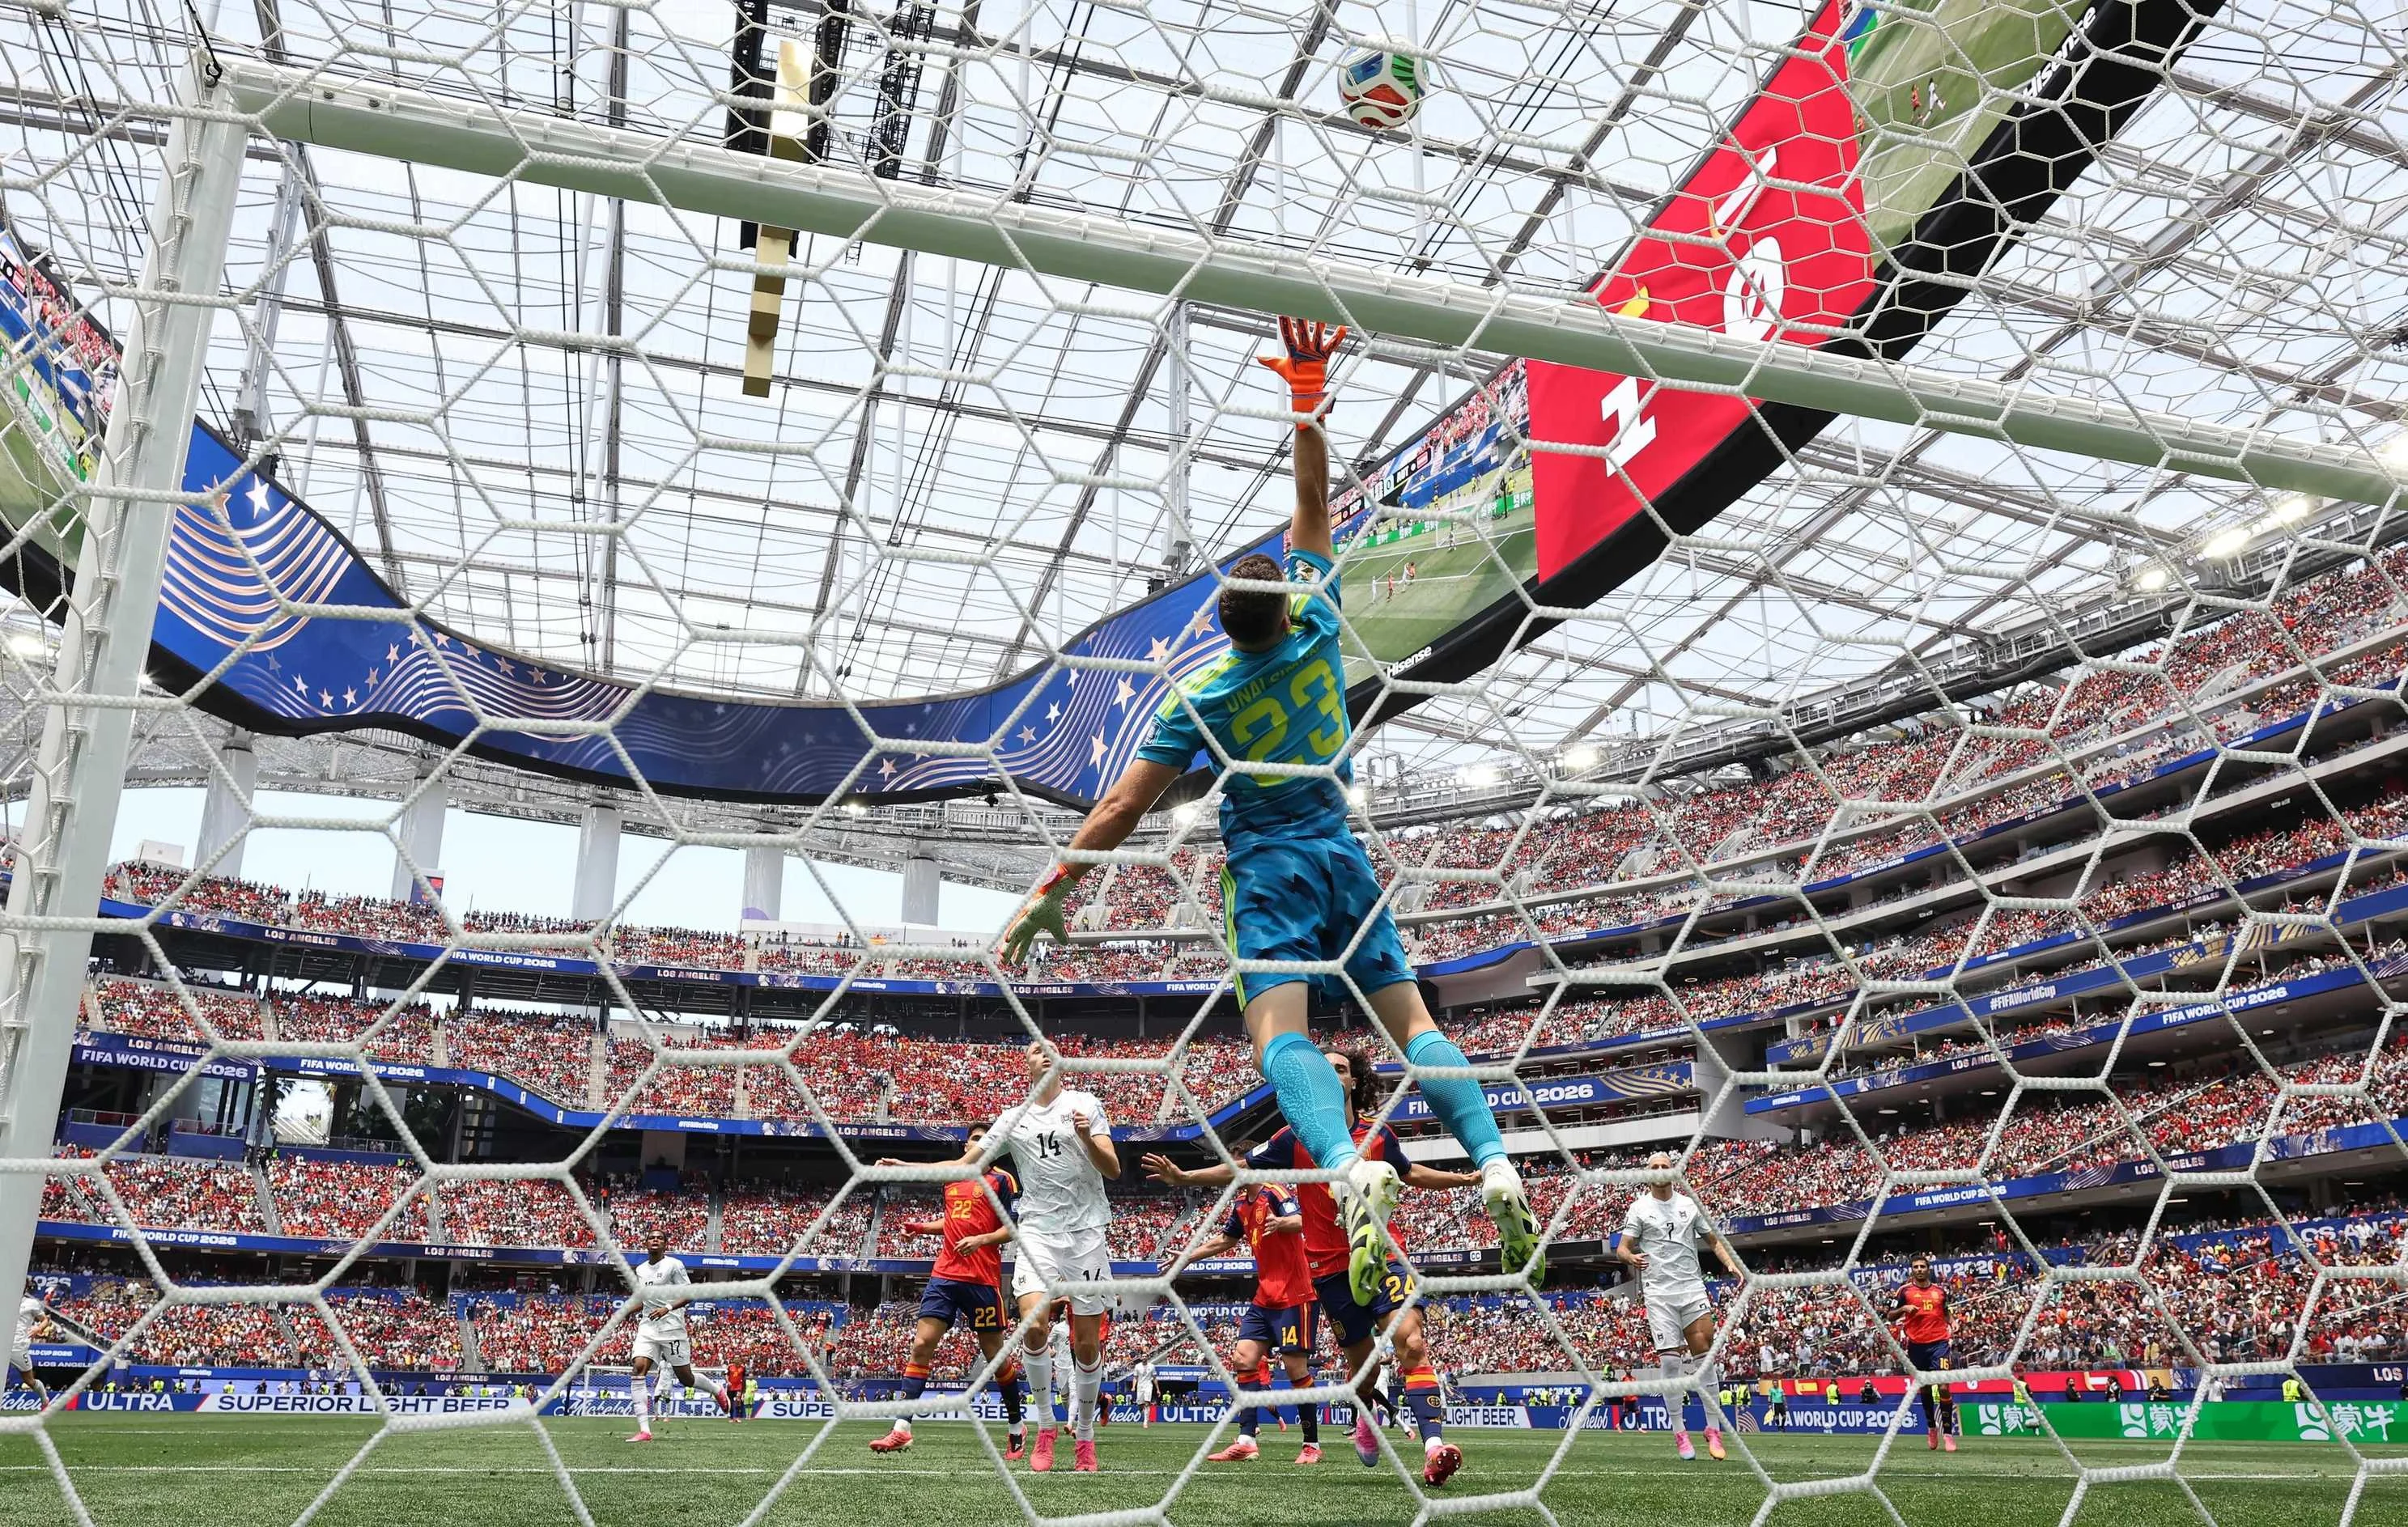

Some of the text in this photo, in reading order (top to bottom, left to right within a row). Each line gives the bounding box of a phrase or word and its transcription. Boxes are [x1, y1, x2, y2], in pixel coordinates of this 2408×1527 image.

[1387, 646, 1432, 677] Hisense
[1225, 677, 1268, 713] UNAI
[1231, 659, 1345, 788] 23
[2172, 893, 2219, 910] LOS ANGELES
[265, 930, 338, 945] LOS ANGELES
[469, 952, 503, 964] WORLD
[503, 955, 522, 965] CUP
[524, 958, 557, 968] 2026
[657, 969, 721, 981] LOS ANGELES
[1013, 986, 1074, 995] LOS ANGELES
[1166, 983, 1184, 991] FIFA
[1185, 982, 1216, 991] WORLD
[1990, 985, 2056, 1011] #FIFAWorldCup
[2163, 1009, 2185, 1024] FIFA
[2224, 997, 2247, 1011] CUP
[2248, 986, 2288, 1005] 2026
[129, 1039, 210, 1056] LOS ANGELES
[82, 1050, 113, 1063] FIFA
[117, 1053, 168, 1069] WORLD
[202, 1064, 248, 1078] 2026
[300, 1058, 324, 1070] FIFA
[388, 1066, 425, 1076] 2026
[1951, 1058, 1969, 1070] LOS
[1536, 1084, 1594, 1102] 2026
[839, 1126, 908, 1138] LOS ANGELES
[1036, 1130, 1062, 1159] 14
[2134, 1164, 2155, 1176] LOS
[1915, 1195, 1932, 1206] FIFA
[1932, 1192, 1960, 1203] WORLD
[1960, 1189, 1977, 1200] CUP
[951, 1200, 972, 1219] 22
[1764, 1213, 1812, 1226] LOS ANGELES
[177, 1232, 199, 1243] CUP
[200, 1234, 237, 1245] 2026
[1667, 1222, 1675, 1240] 7
[424, 1247, 494, 1258] LOS ANGELES
[1423, 1253, 1463, 1263] ANGELES
[1183, 1262, 1205, 1270] ORLD
[1206, 1262, 1223, 1270] CUP
[1386, 1274, 1416, 1303] 24
[1230, 1306, 1250, 1317] CU
[1922, 1299, 1934, 1312] 16
[975, 1306, 997, 1328] 22
[1281, 1325, 1298, 1347] 14
[669, 1339, 681, 1355] 17
[1939, 1357, 1949, 1370] 16
[2373, 1367, 2403, 1381] LOS
[87, 1393, 175, 1411] ULTRA
[218, 1396, 510, 1413] SUPERIOR LGHT BEER
[1163, 1406, 1227, 1422] ULTRA
[1329, 1406, 1353, 1424] ULTR
[1444, 1407, 1517, 1425] LIGHT BEER
[1794, 1410, 1838, 1427] WORLD
[1839, 1410, 1864, 1427] CUP
[2332, 1402, 2395, 1441] 蒙牛
